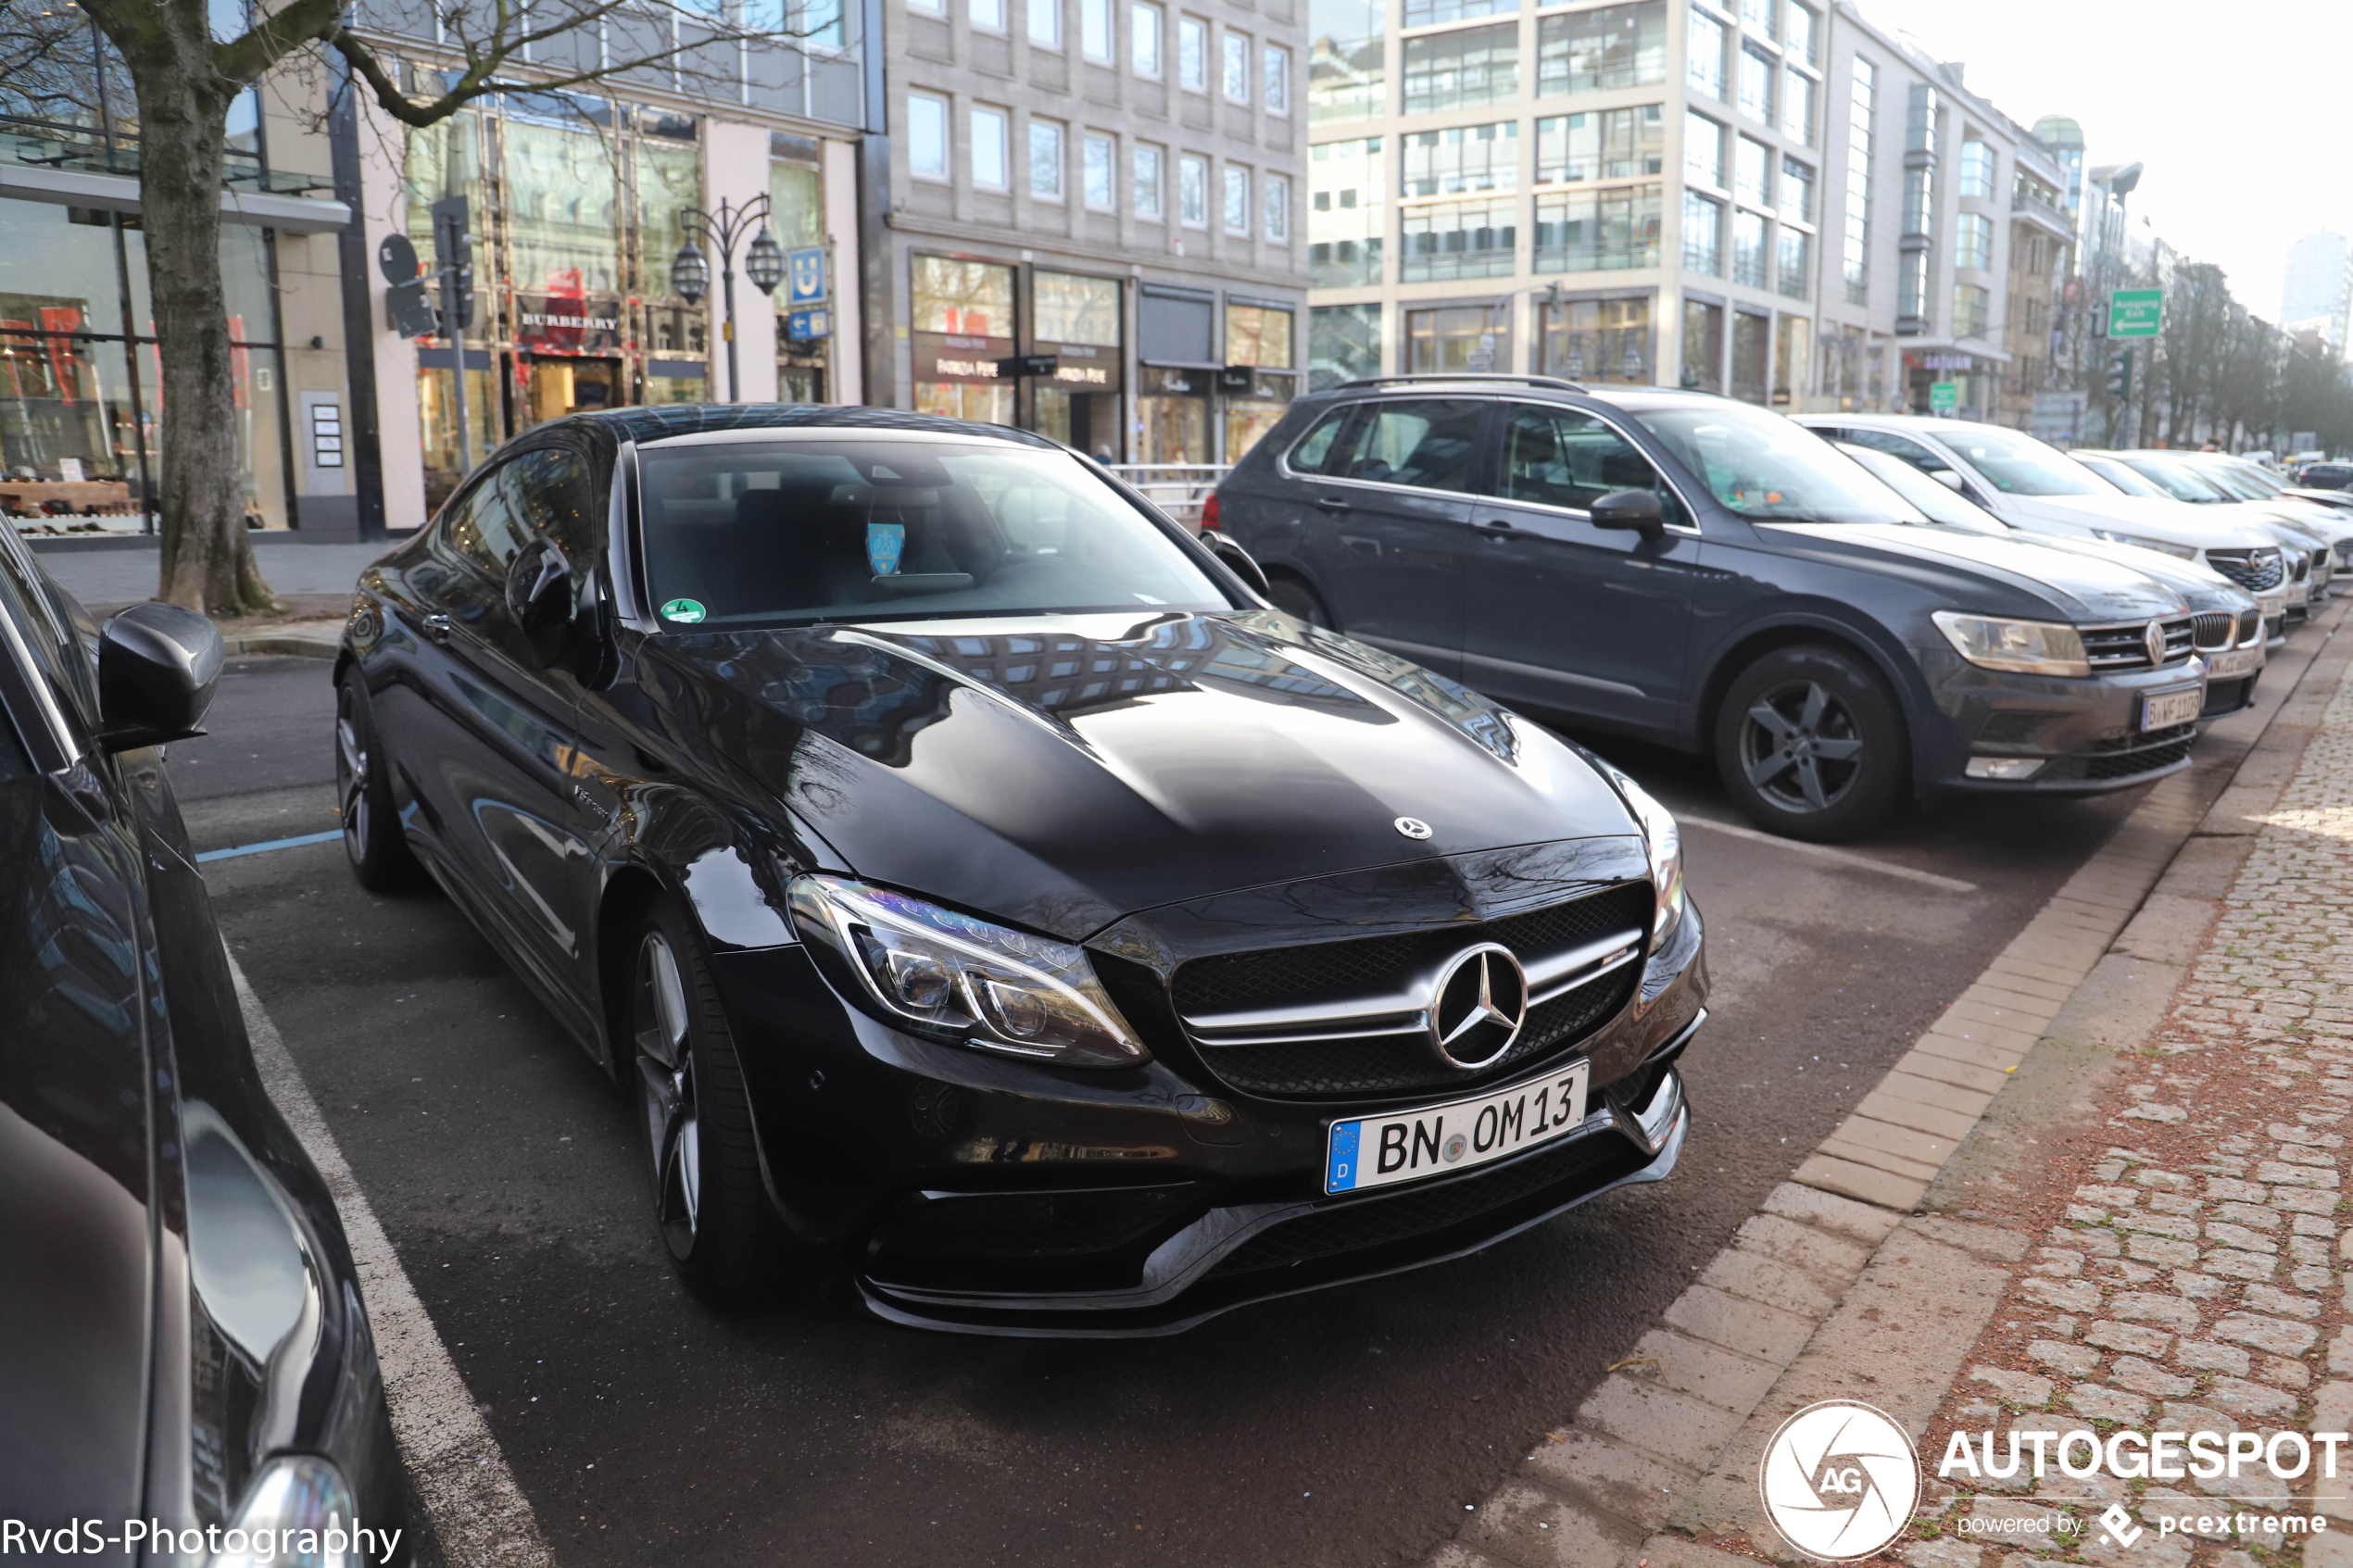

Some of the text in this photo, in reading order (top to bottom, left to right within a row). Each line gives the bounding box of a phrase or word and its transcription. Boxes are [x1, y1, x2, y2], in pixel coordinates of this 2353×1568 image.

[795, 257, 819, 296] U
[522, 313, 618, 331] BURBERRY
[676, 600, 688, 612] 4
[1378, 1076, 1574, 1174] BN OM 13
[1338, 1163, 1348, 1179] D
